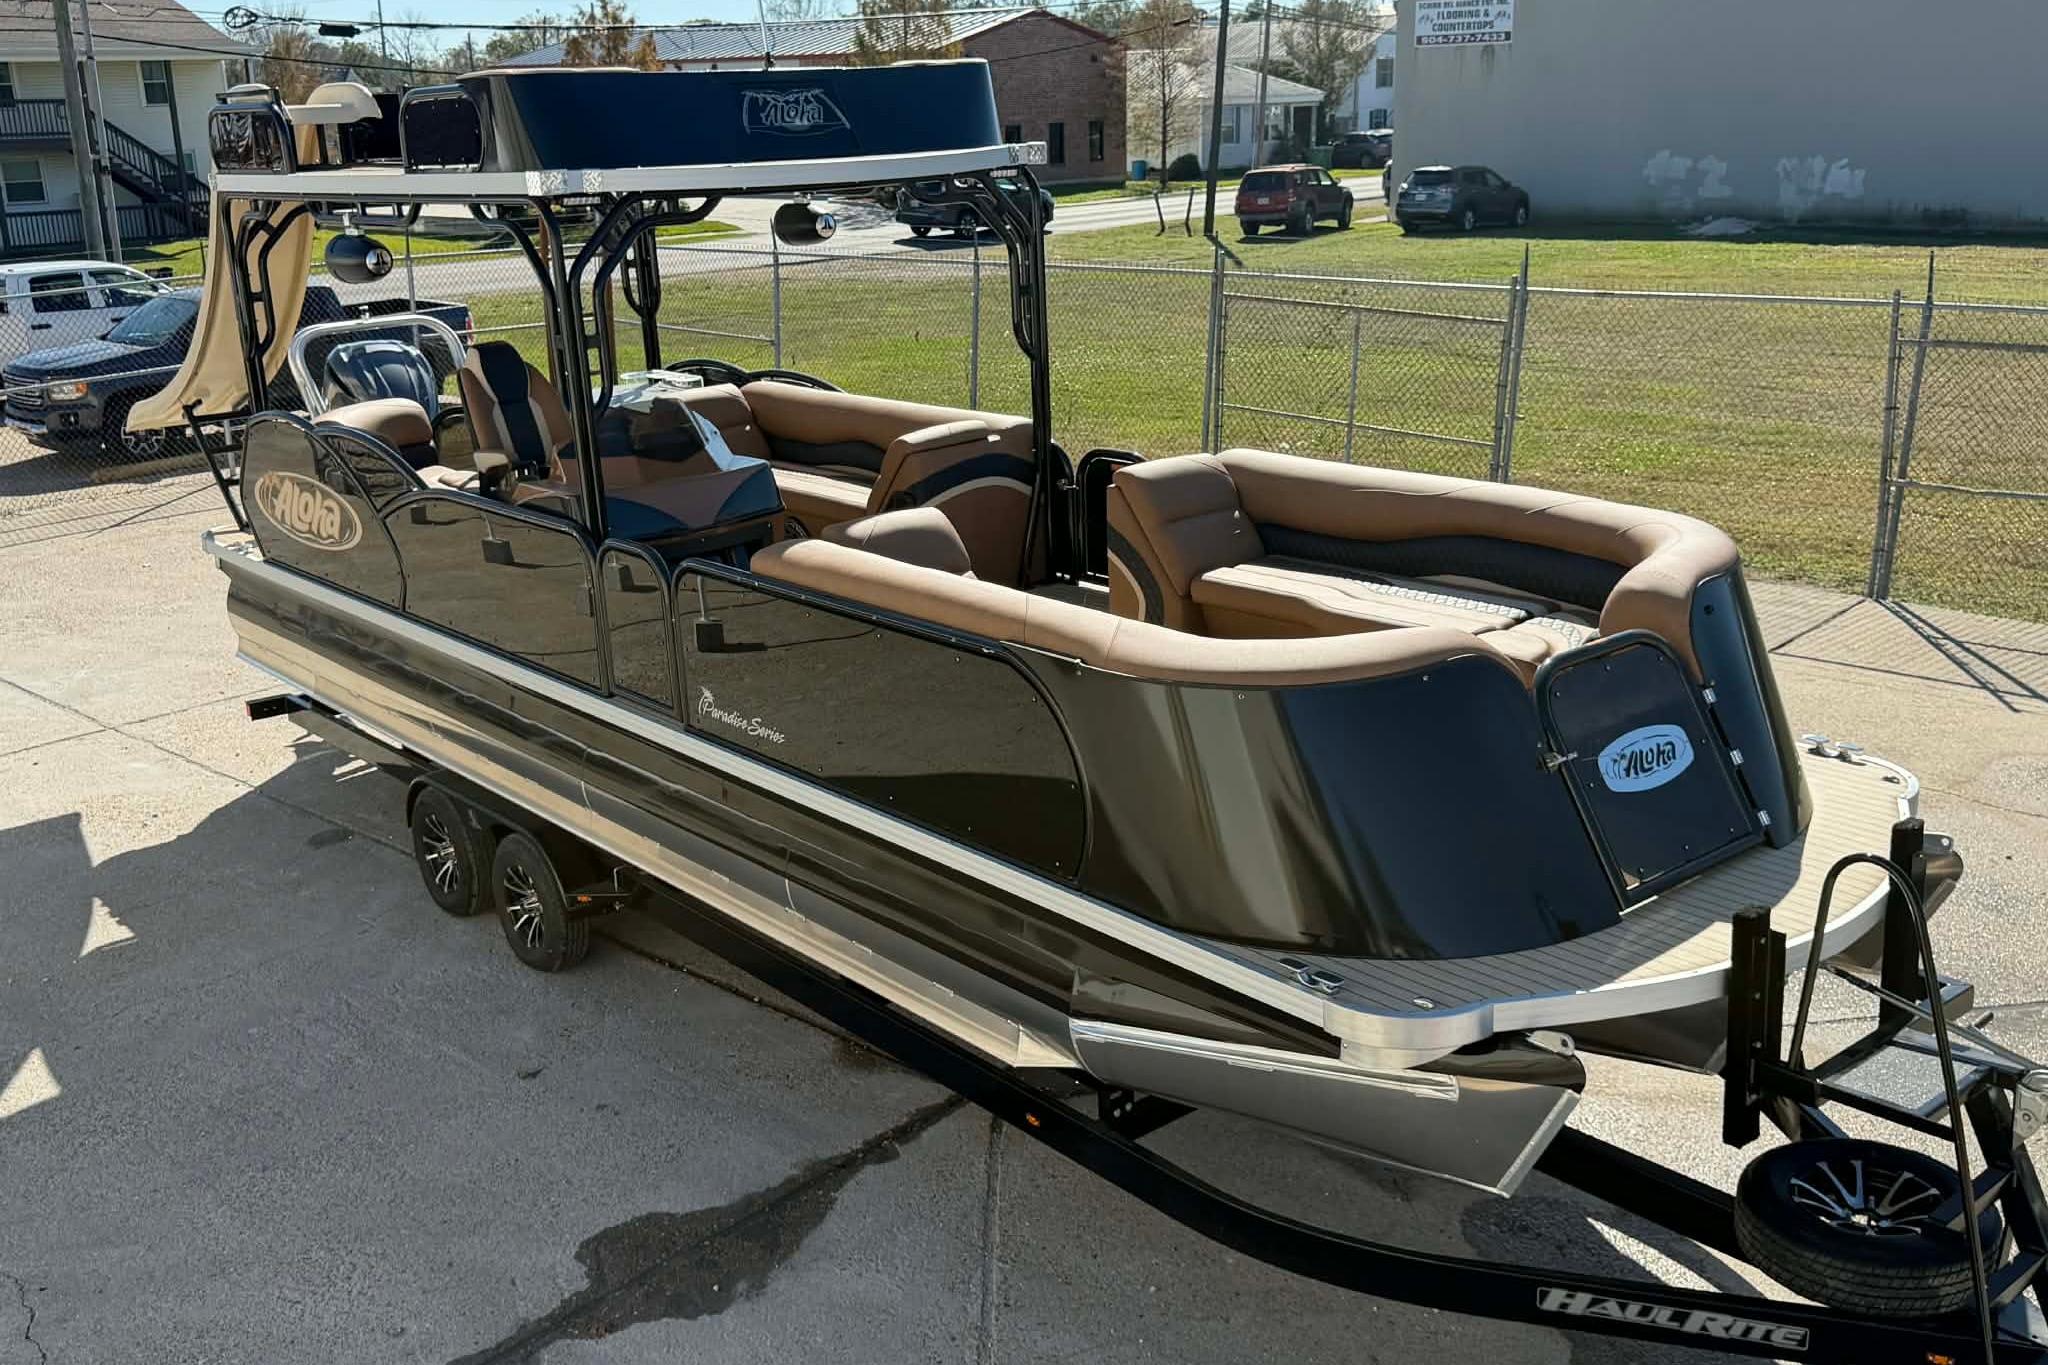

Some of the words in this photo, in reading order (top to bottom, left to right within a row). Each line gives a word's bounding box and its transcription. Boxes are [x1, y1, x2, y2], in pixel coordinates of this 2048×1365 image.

[1437, 8, 1481, 20] FLOORING
[1432, 20, 1494, 32] COUNTERTOPS
[703, 698, 748, 730] Paradise
[747, 718, 785, 744] Series
